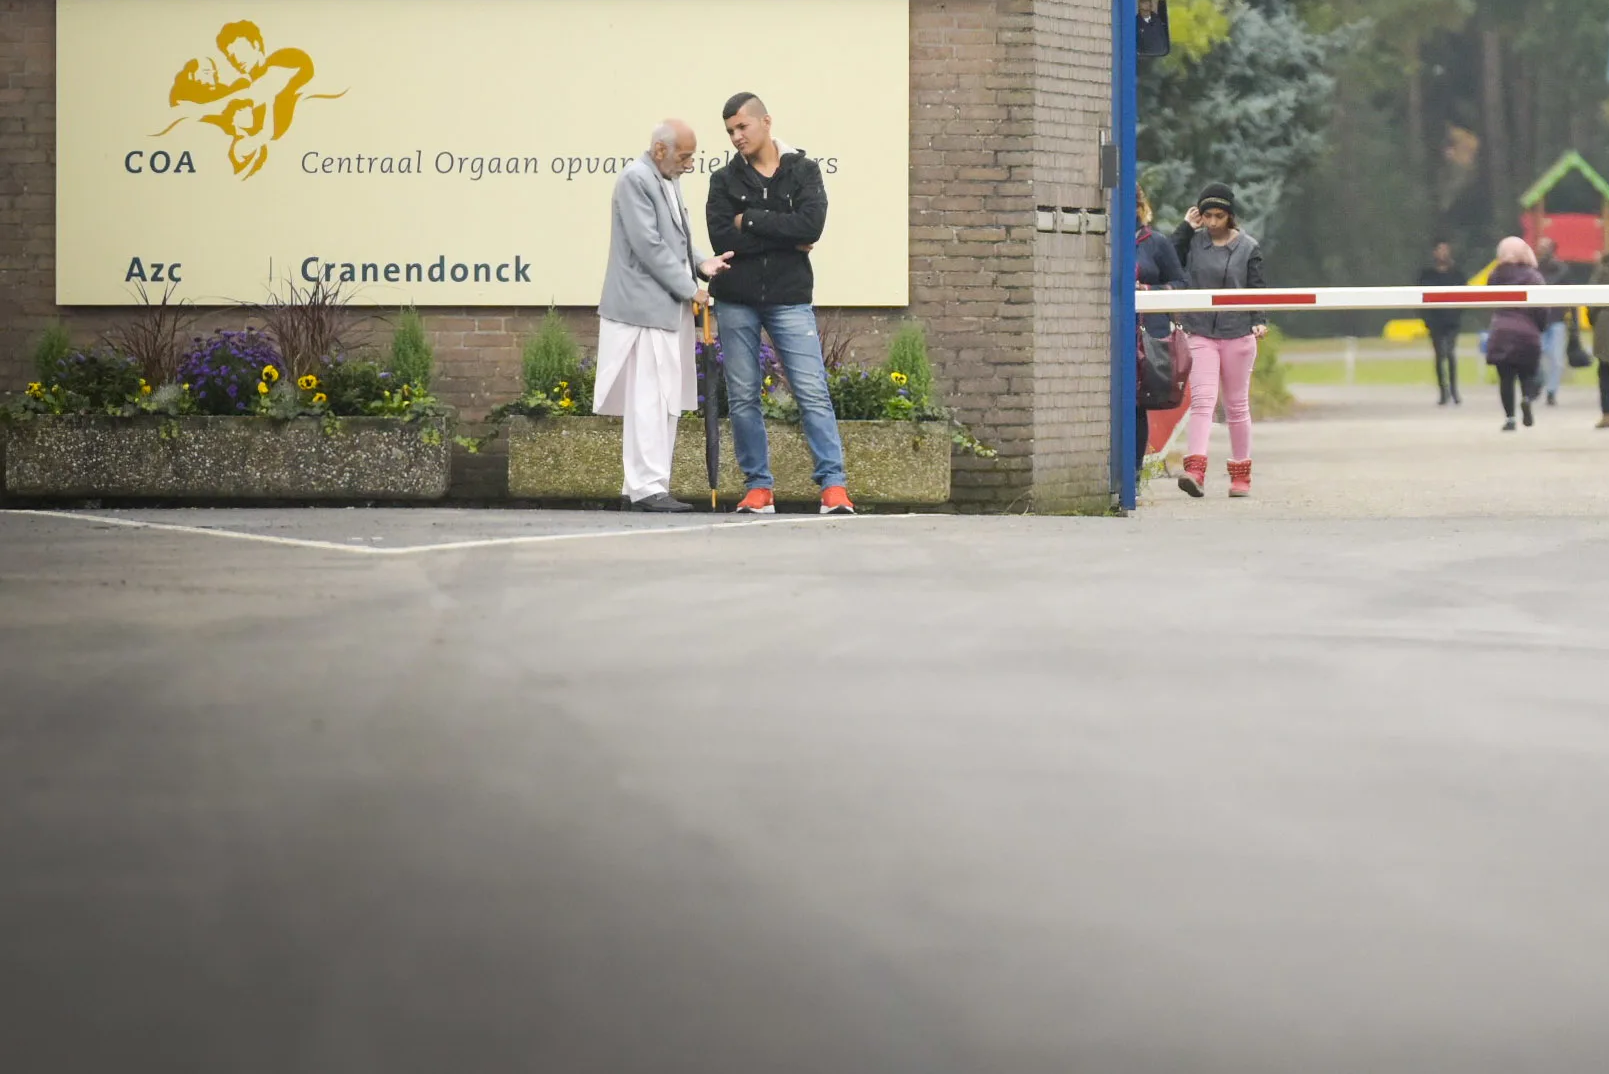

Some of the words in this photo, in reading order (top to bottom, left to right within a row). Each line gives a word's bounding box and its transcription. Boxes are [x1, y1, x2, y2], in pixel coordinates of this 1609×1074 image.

[124, 150, 197, 174] COA
[301, 149, 423, 174] Centraal
[434, 151, 540, 181] Orgaan
[124, 256, 183, 283] Azc
[300, 254, 533, 283] Cranendonck
